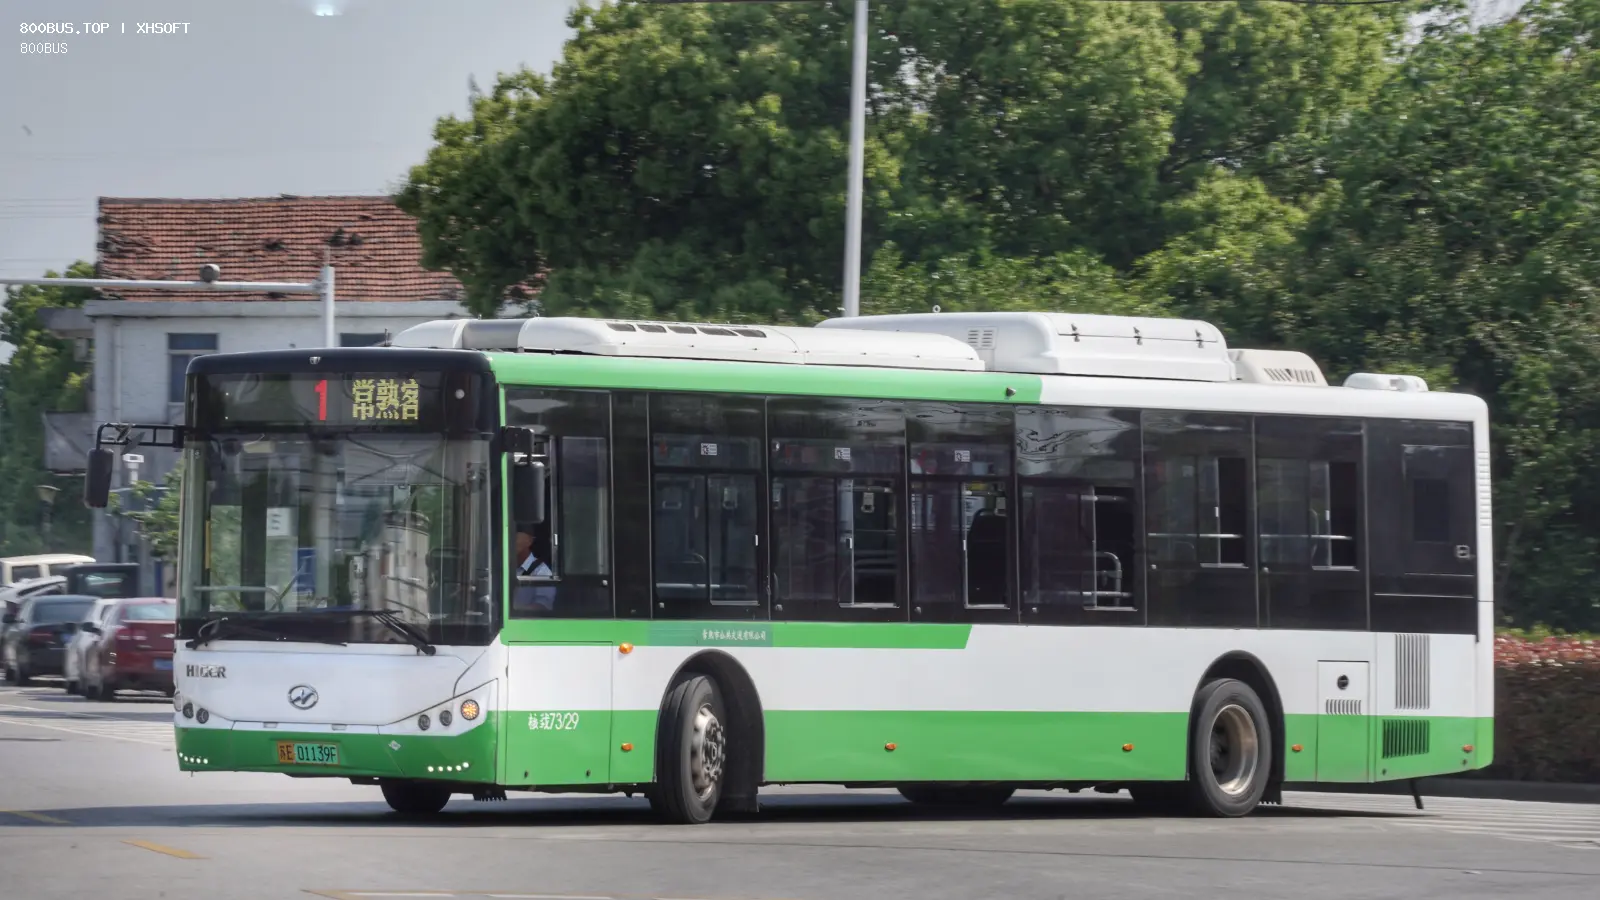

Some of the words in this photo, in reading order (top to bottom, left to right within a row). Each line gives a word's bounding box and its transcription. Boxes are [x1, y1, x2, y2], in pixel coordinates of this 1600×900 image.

[314, 379, 327, 421] 1
[351, 378, 419, 421] 常熟客
[185, 664, 227, 679] HIGER
